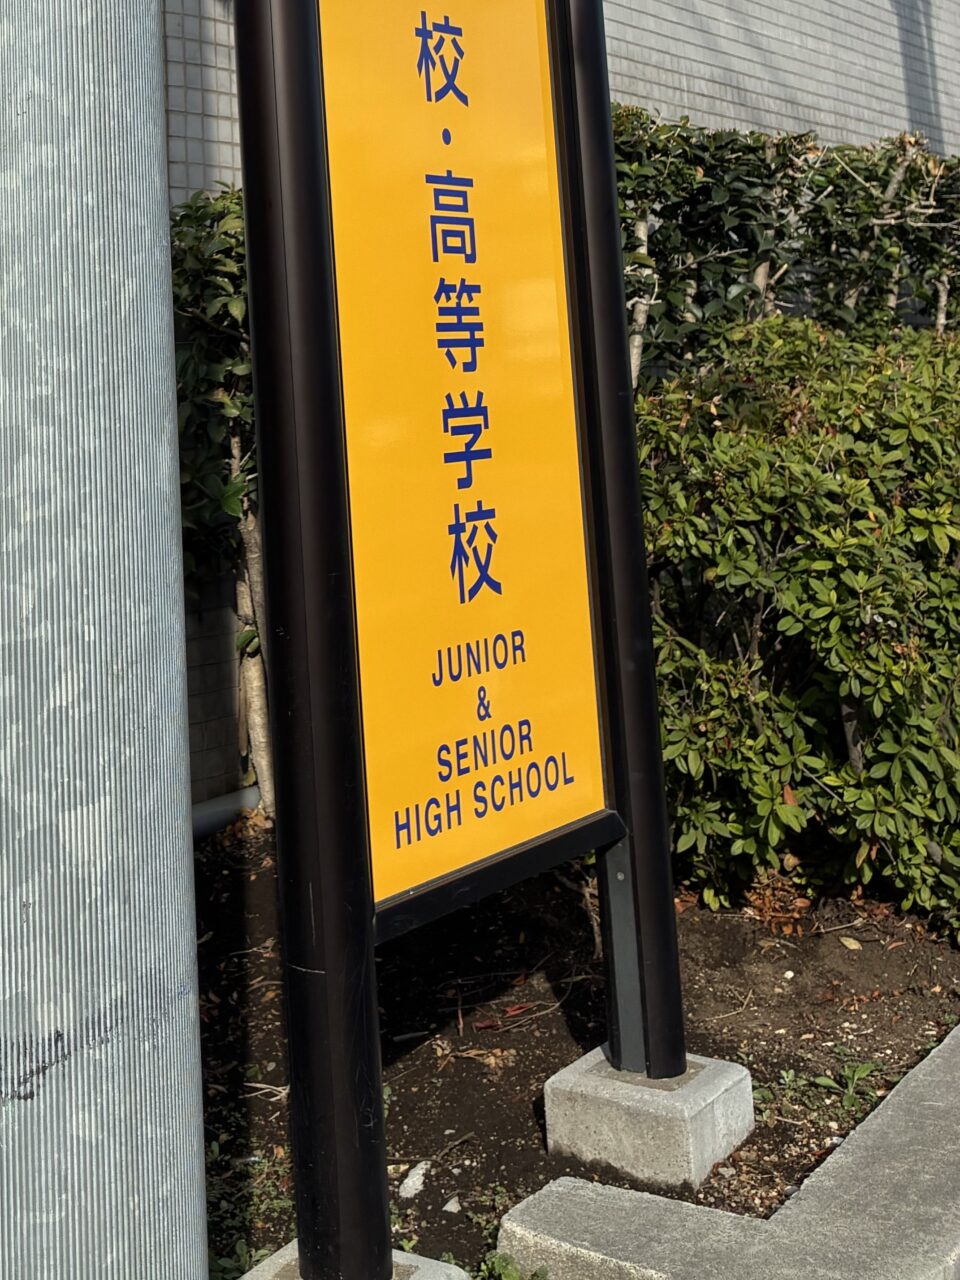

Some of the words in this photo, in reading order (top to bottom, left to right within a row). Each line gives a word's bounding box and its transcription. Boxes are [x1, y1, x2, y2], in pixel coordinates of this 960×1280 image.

[432, 630, 526, 687] JUNIOR
[477, 686, 492, 721] &
[437, 719, 532, 782] SENIOR
[394, 790, 462, 848] HIGH
[473, 752, 574, 818] SCHOOL
